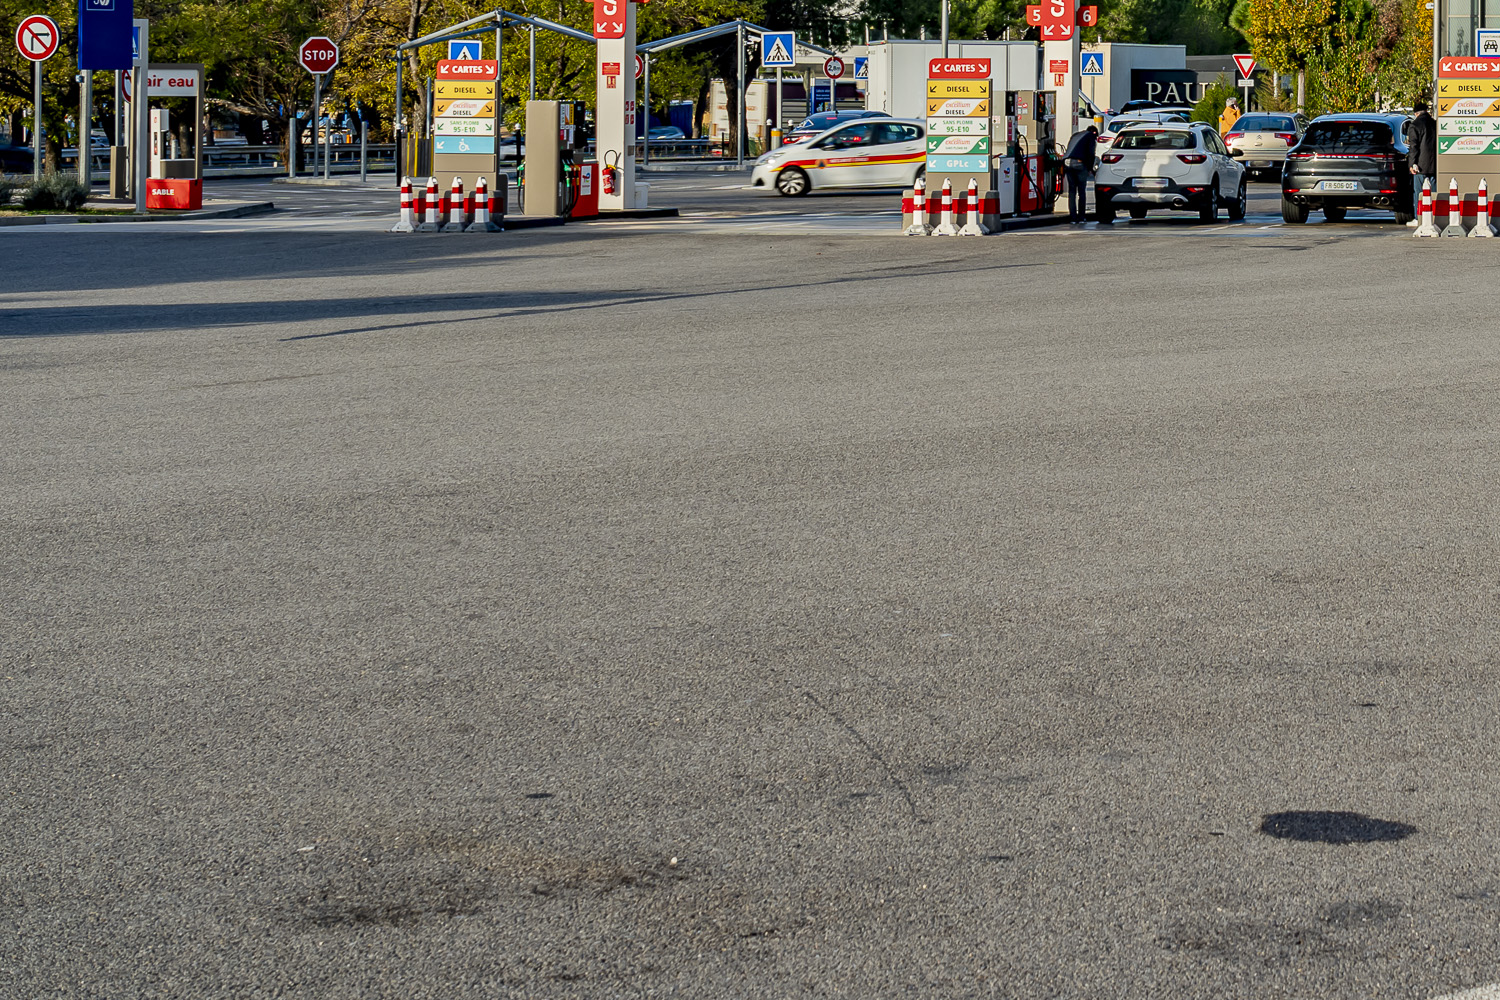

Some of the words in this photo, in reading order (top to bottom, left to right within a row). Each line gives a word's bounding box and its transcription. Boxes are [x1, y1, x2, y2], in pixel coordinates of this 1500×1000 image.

[1033, 9, 1041, 22] 5
[1083, 10, 1091, 22] 6
[304, 50, 335, 61] STOP
[452, 65, 483, 74] CARTES
[944, 64, 976, 72] CARTES
[1455, 63, 1488, 71] CARTES
[147, 74, 164, 87] air
[167, 77, 194, 87] eau
[454, 86, 477, 94] DIESEL
[1145, 82, 1219, 103] PAU
[946, 160, 969, 168] GPLc
[152, 188, 175, 196] SABLE
